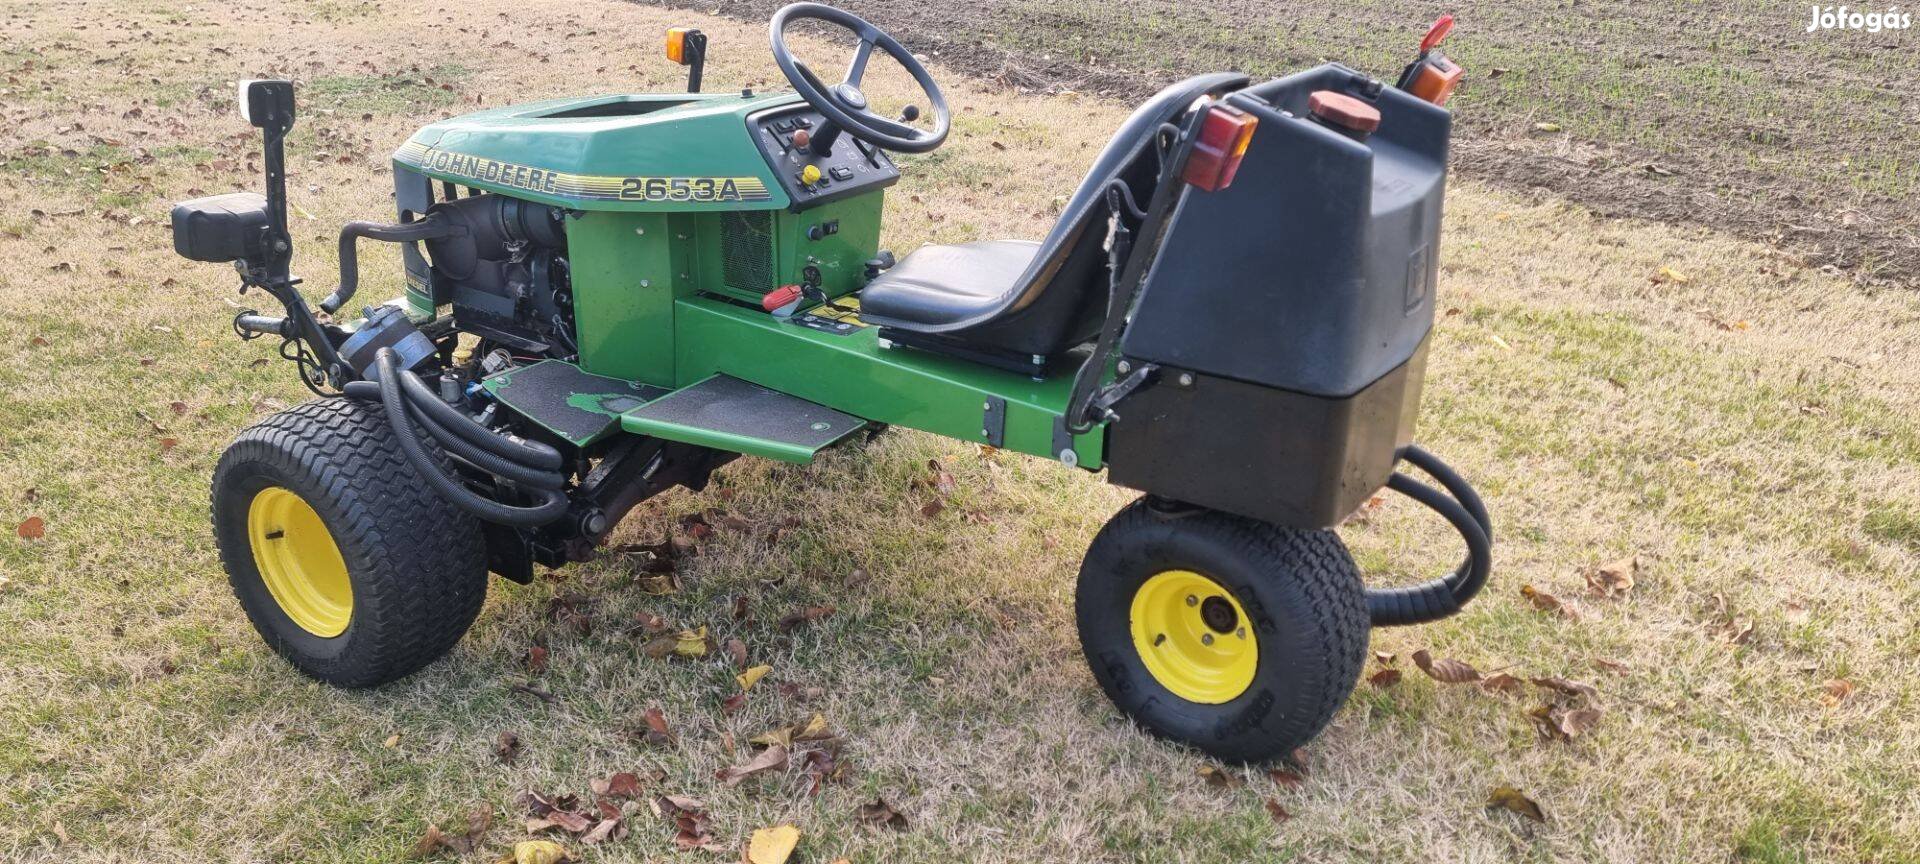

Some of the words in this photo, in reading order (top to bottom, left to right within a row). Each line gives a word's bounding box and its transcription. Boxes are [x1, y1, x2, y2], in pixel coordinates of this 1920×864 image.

[421, 150, 480, 178] JOHN
[483, 160, 557, 194] DEERE
[620, 177, 742, 201] 2653A
